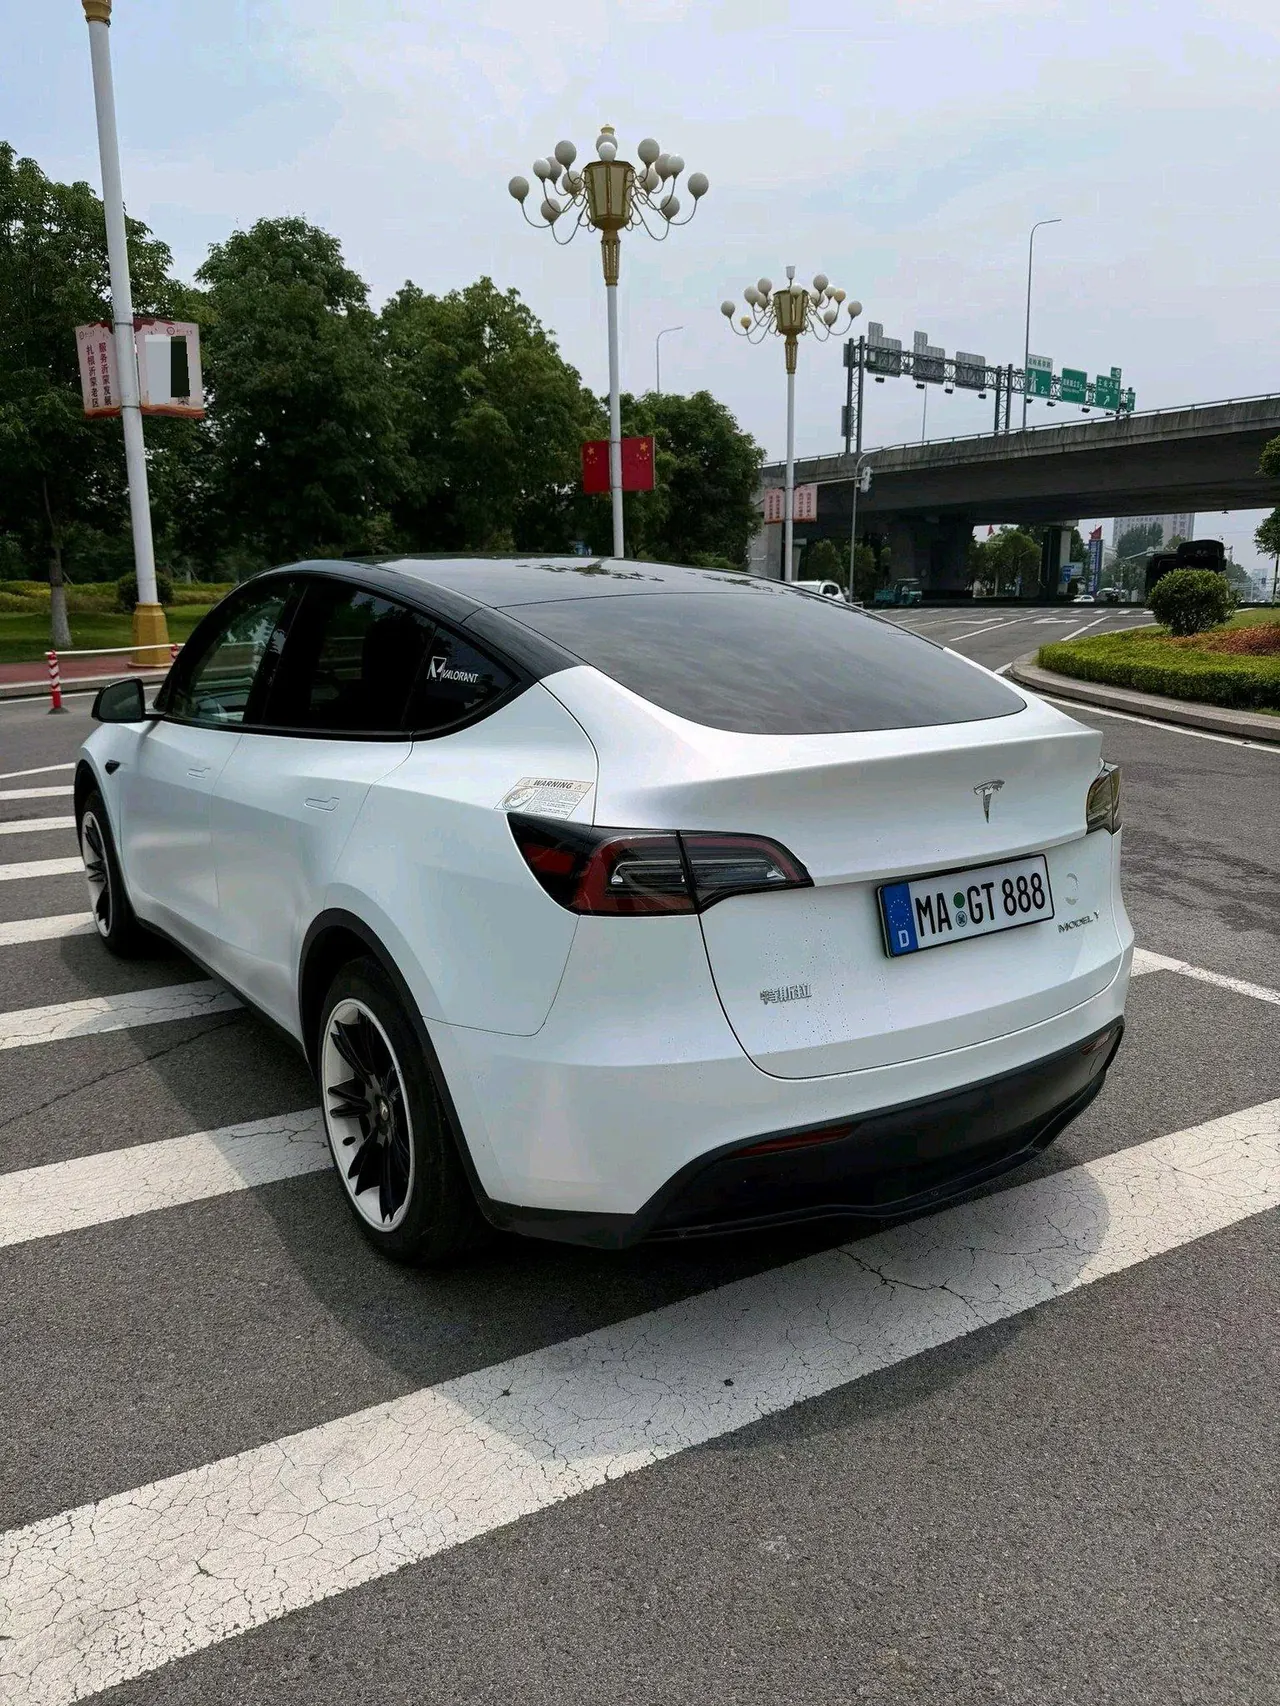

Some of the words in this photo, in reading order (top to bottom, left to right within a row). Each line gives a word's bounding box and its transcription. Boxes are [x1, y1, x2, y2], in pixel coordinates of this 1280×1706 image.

[442, 669, 478, 683] VALORANT
[533, 779, 574, 789] WARNING
[915, 892, 953, 937] MA
[966, 881, 995, 925] GT
[1001, 872, 1046, 917] 888
[1057, 914, 1093, 934] MODEL
[1093, 909, 1101, 921] Y
[898, 929, 910, 948] D
